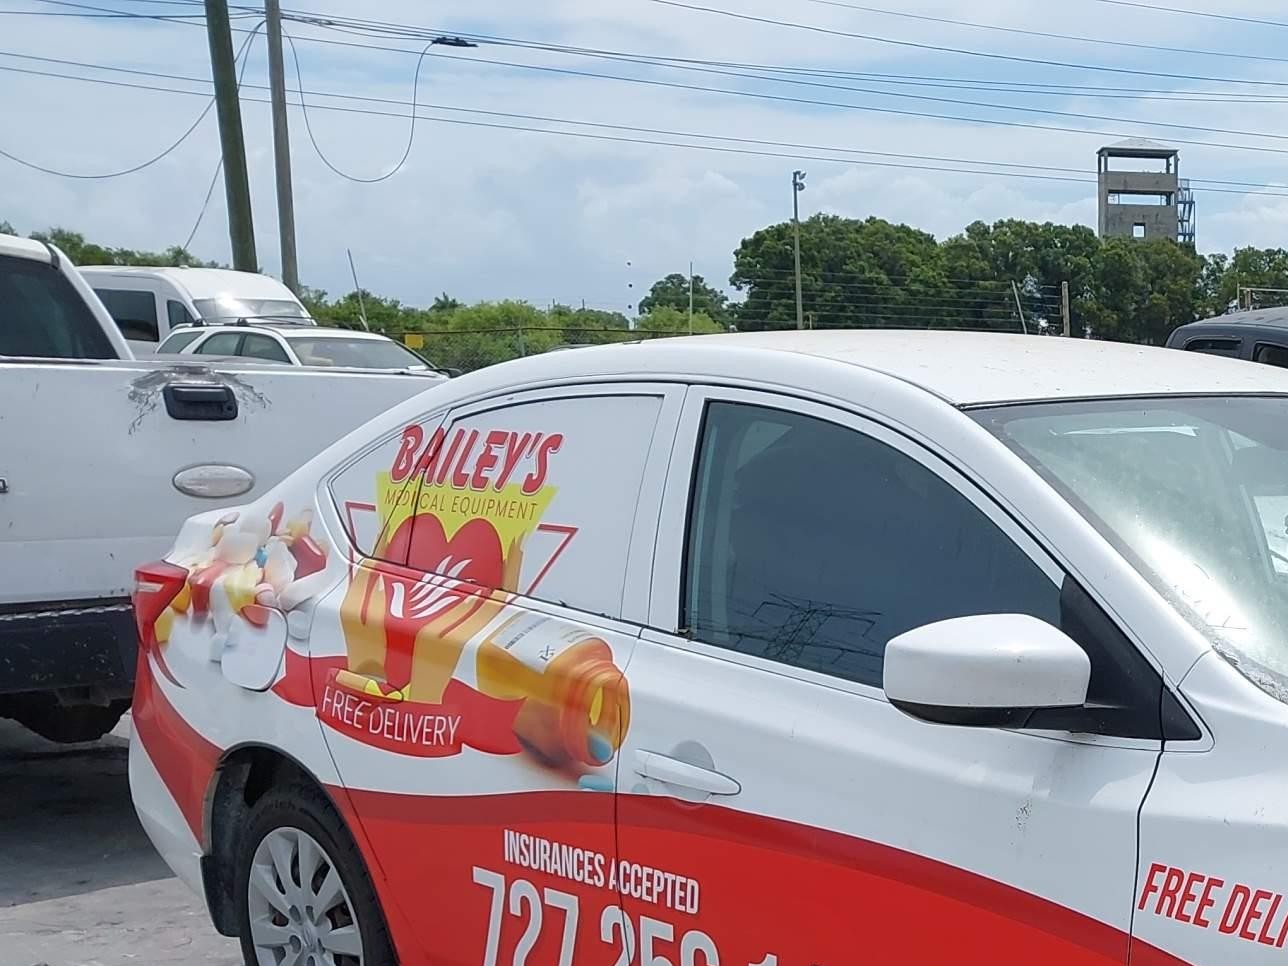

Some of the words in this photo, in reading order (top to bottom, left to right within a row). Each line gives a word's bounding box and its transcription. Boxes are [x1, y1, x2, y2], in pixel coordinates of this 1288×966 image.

[391, 424, 565, 495] BAILEY'S
[384, 489, 445, 511] MEDICAL
[451, 496, 538, 521] EQUIPMENT
[321, 686, 371, 728] FREE
[369, 702, 462, 746] DELIVERY
[503, 829, 604, 888] INSURANCES
[609, 861, 700, 915] ACCEPTED
[1137, 862, 1225, 928] FREE
